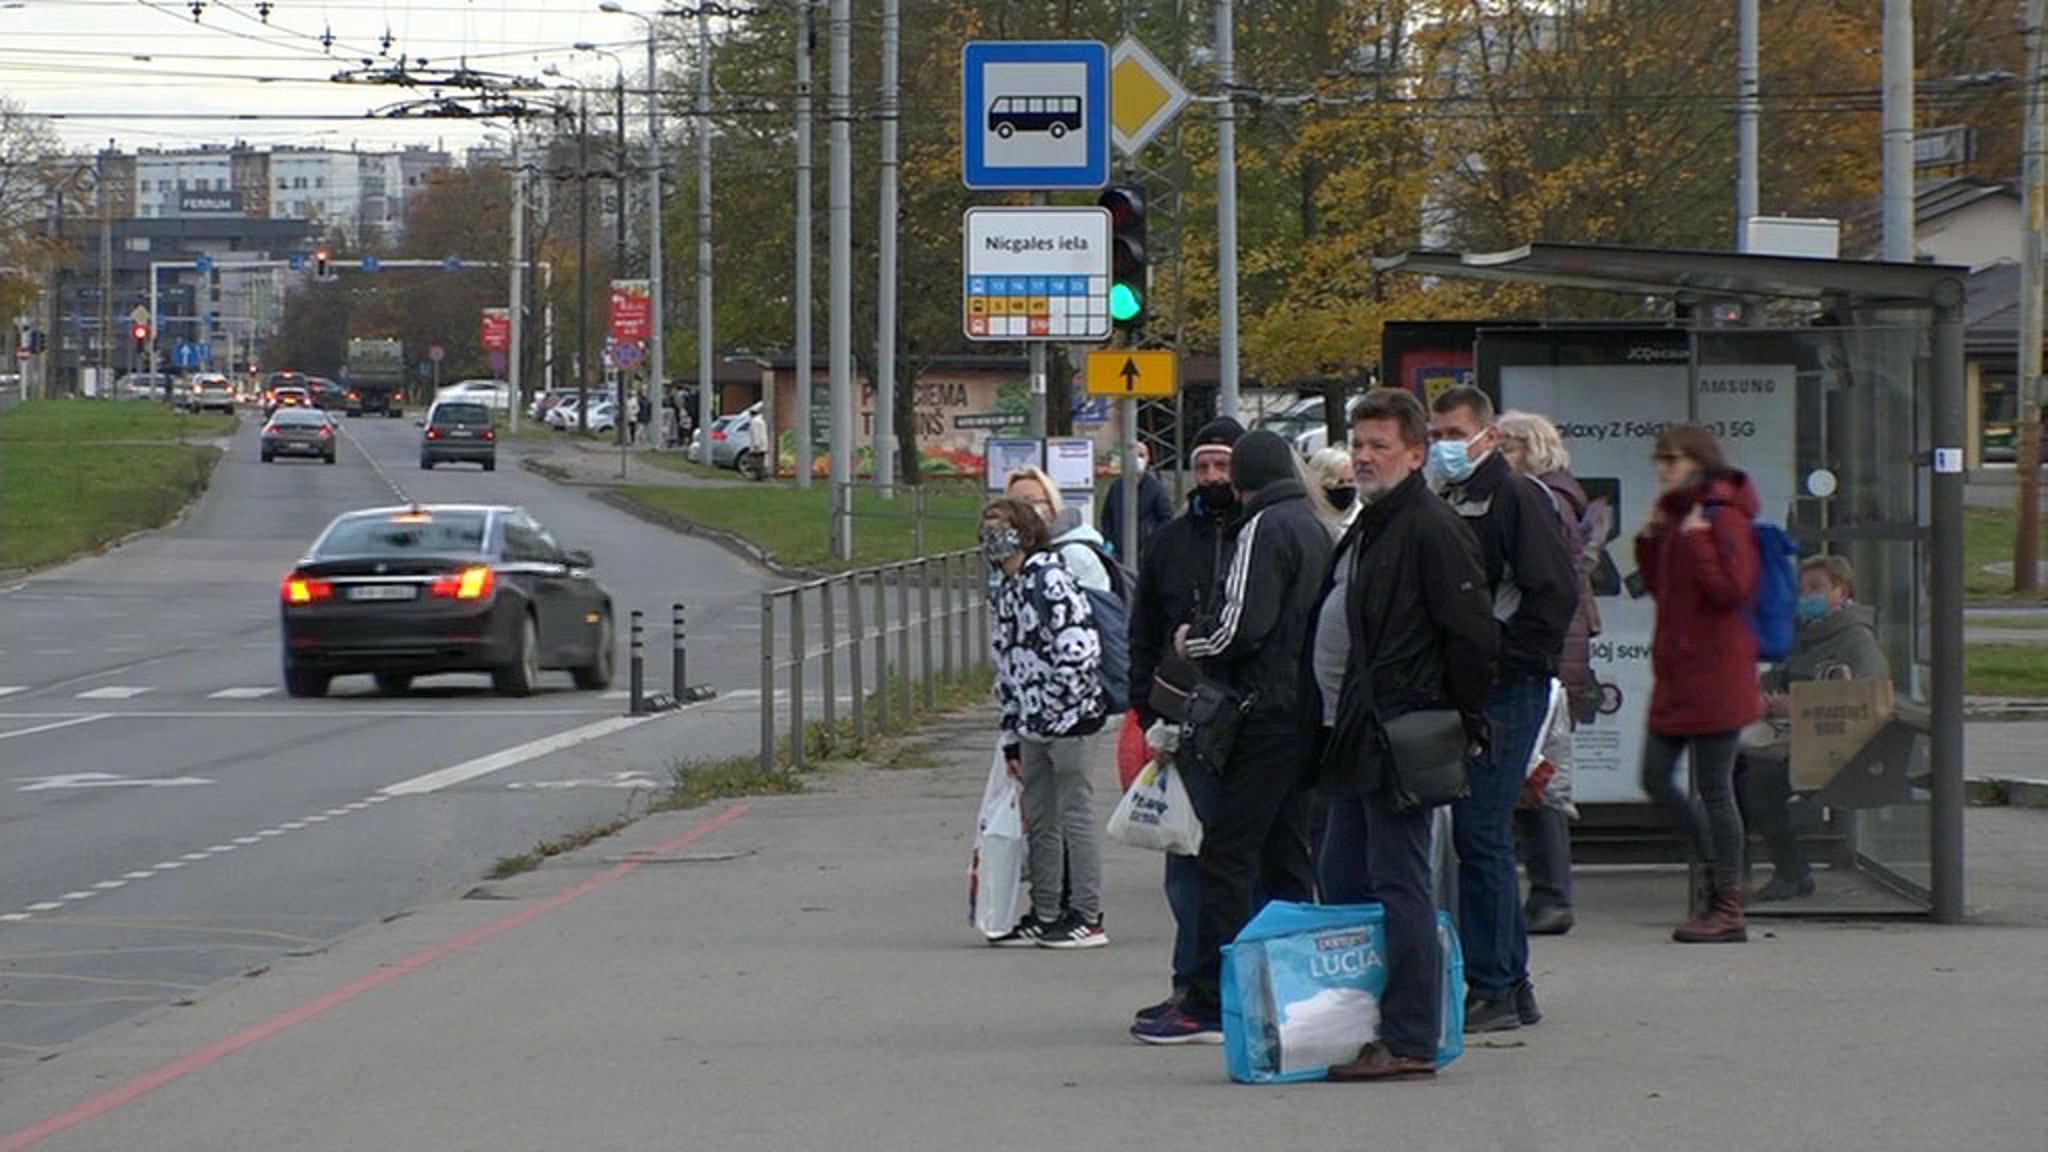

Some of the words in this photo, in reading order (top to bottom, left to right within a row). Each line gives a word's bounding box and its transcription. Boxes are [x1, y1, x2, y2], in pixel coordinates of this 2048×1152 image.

[1059, 235, 1088, 251] iela
[1699, 379, 1776, 394] AMSUNG
[1555, 421, 1609, 442] alaxy
[1730, 421, 1757, 438] 5G
